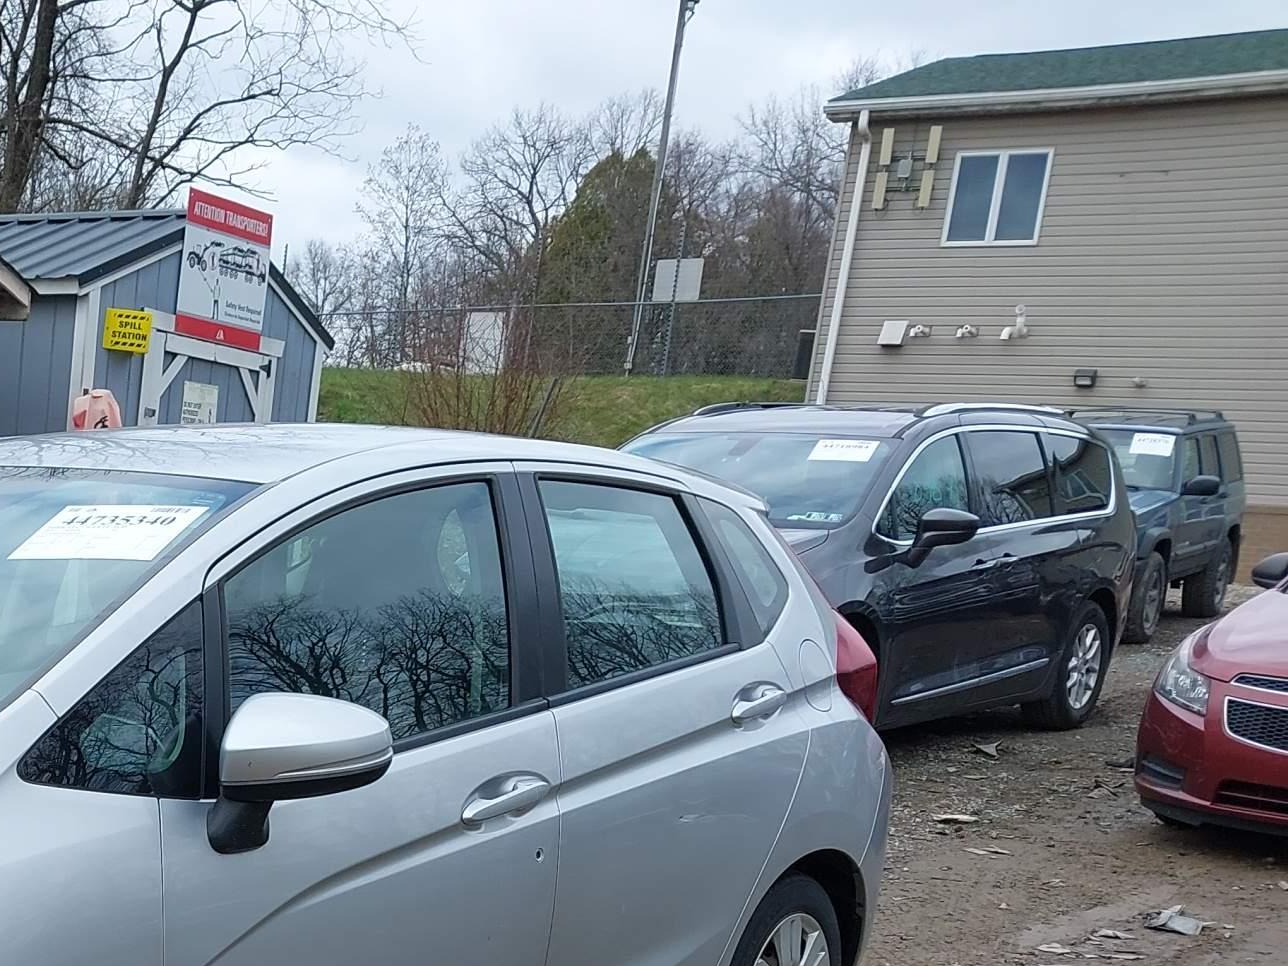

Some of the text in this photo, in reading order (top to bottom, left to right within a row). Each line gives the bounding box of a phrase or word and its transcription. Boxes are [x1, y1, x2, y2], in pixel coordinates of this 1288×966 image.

[193, 201, 269, 237] ATTENTION TRANSPORTERS!
[118, 320, 143, 330] SPILL
[111, 330, 148, 342] STATION
[61, 515, 178, 526] 44735340
